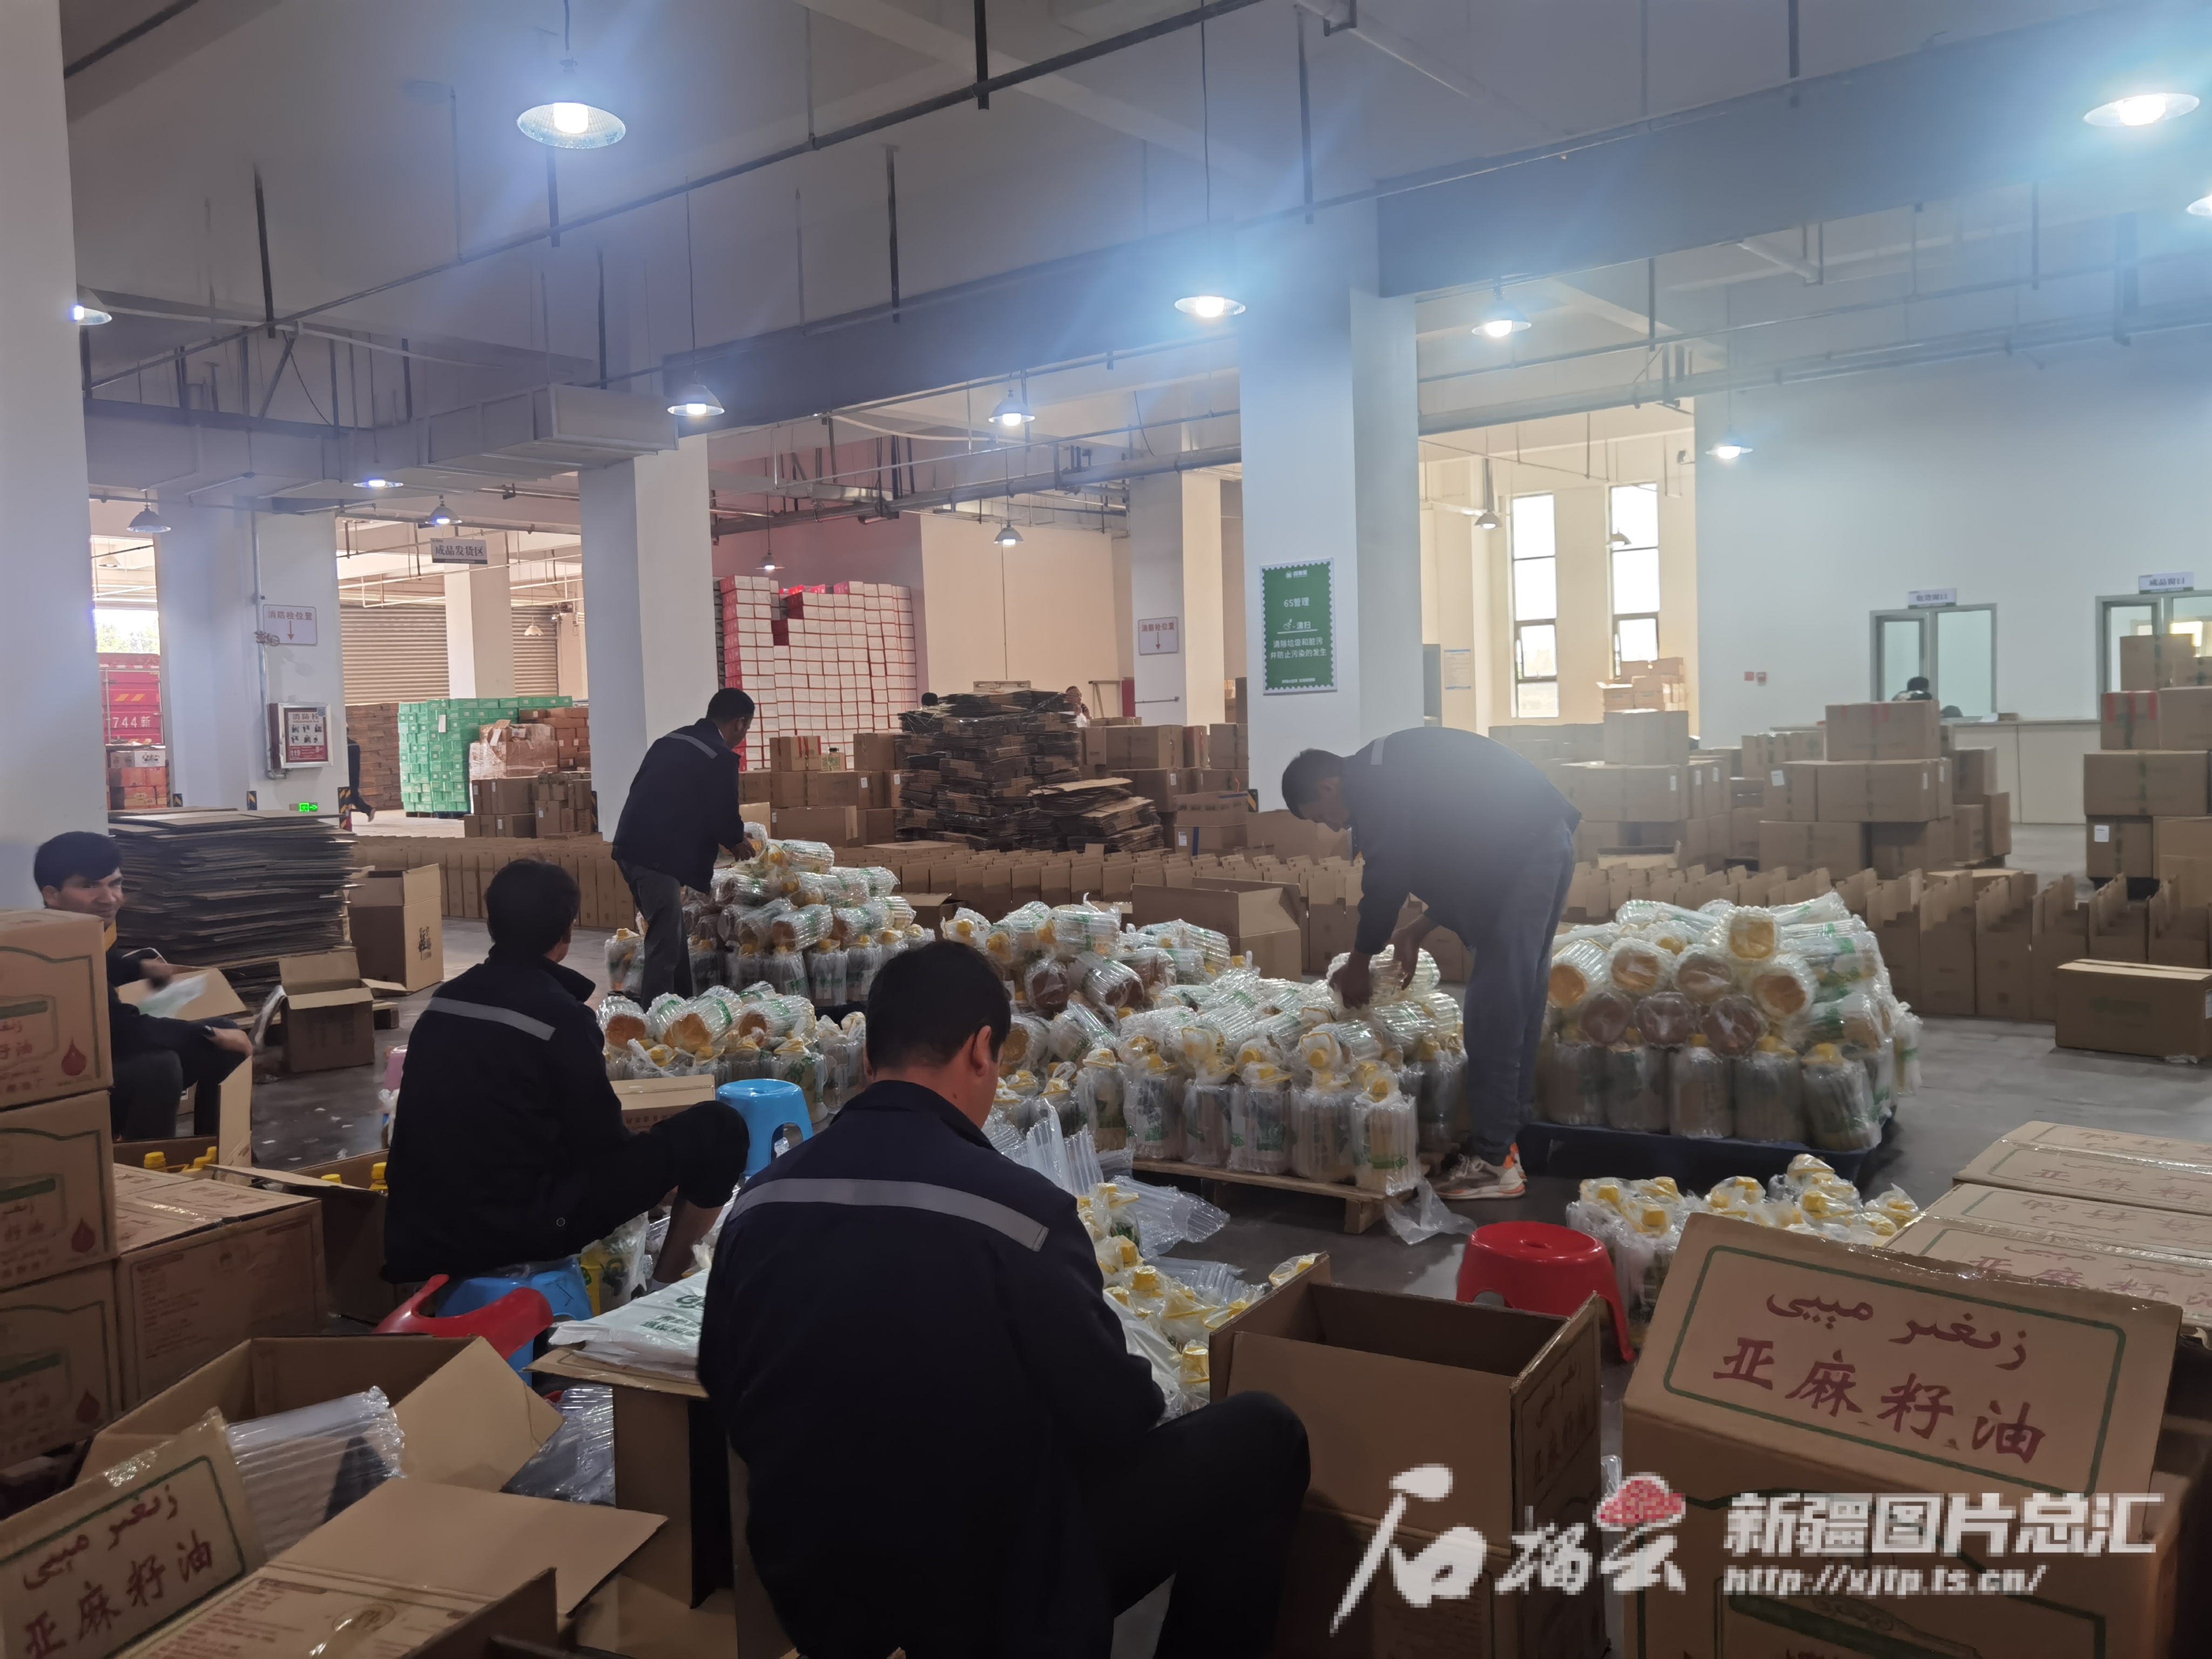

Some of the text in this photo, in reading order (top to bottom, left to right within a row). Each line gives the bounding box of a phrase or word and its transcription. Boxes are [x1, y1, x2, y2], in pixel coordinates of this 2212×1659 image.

[435, 544, 484, 556] 成品发货区
[1284, 597, 1310, 608] 6S管理
[268, 610, 313, 621] 消防栓位置
[1273, 637, 1323, 648] 清除垃圾和脏污
[1270, 649, 1327, 659] 并防止污染的发生
[1713, 1337, 2046, 1464] 亚麻籽油
[25, 1529, 213, 1659] 亚麻籽油
